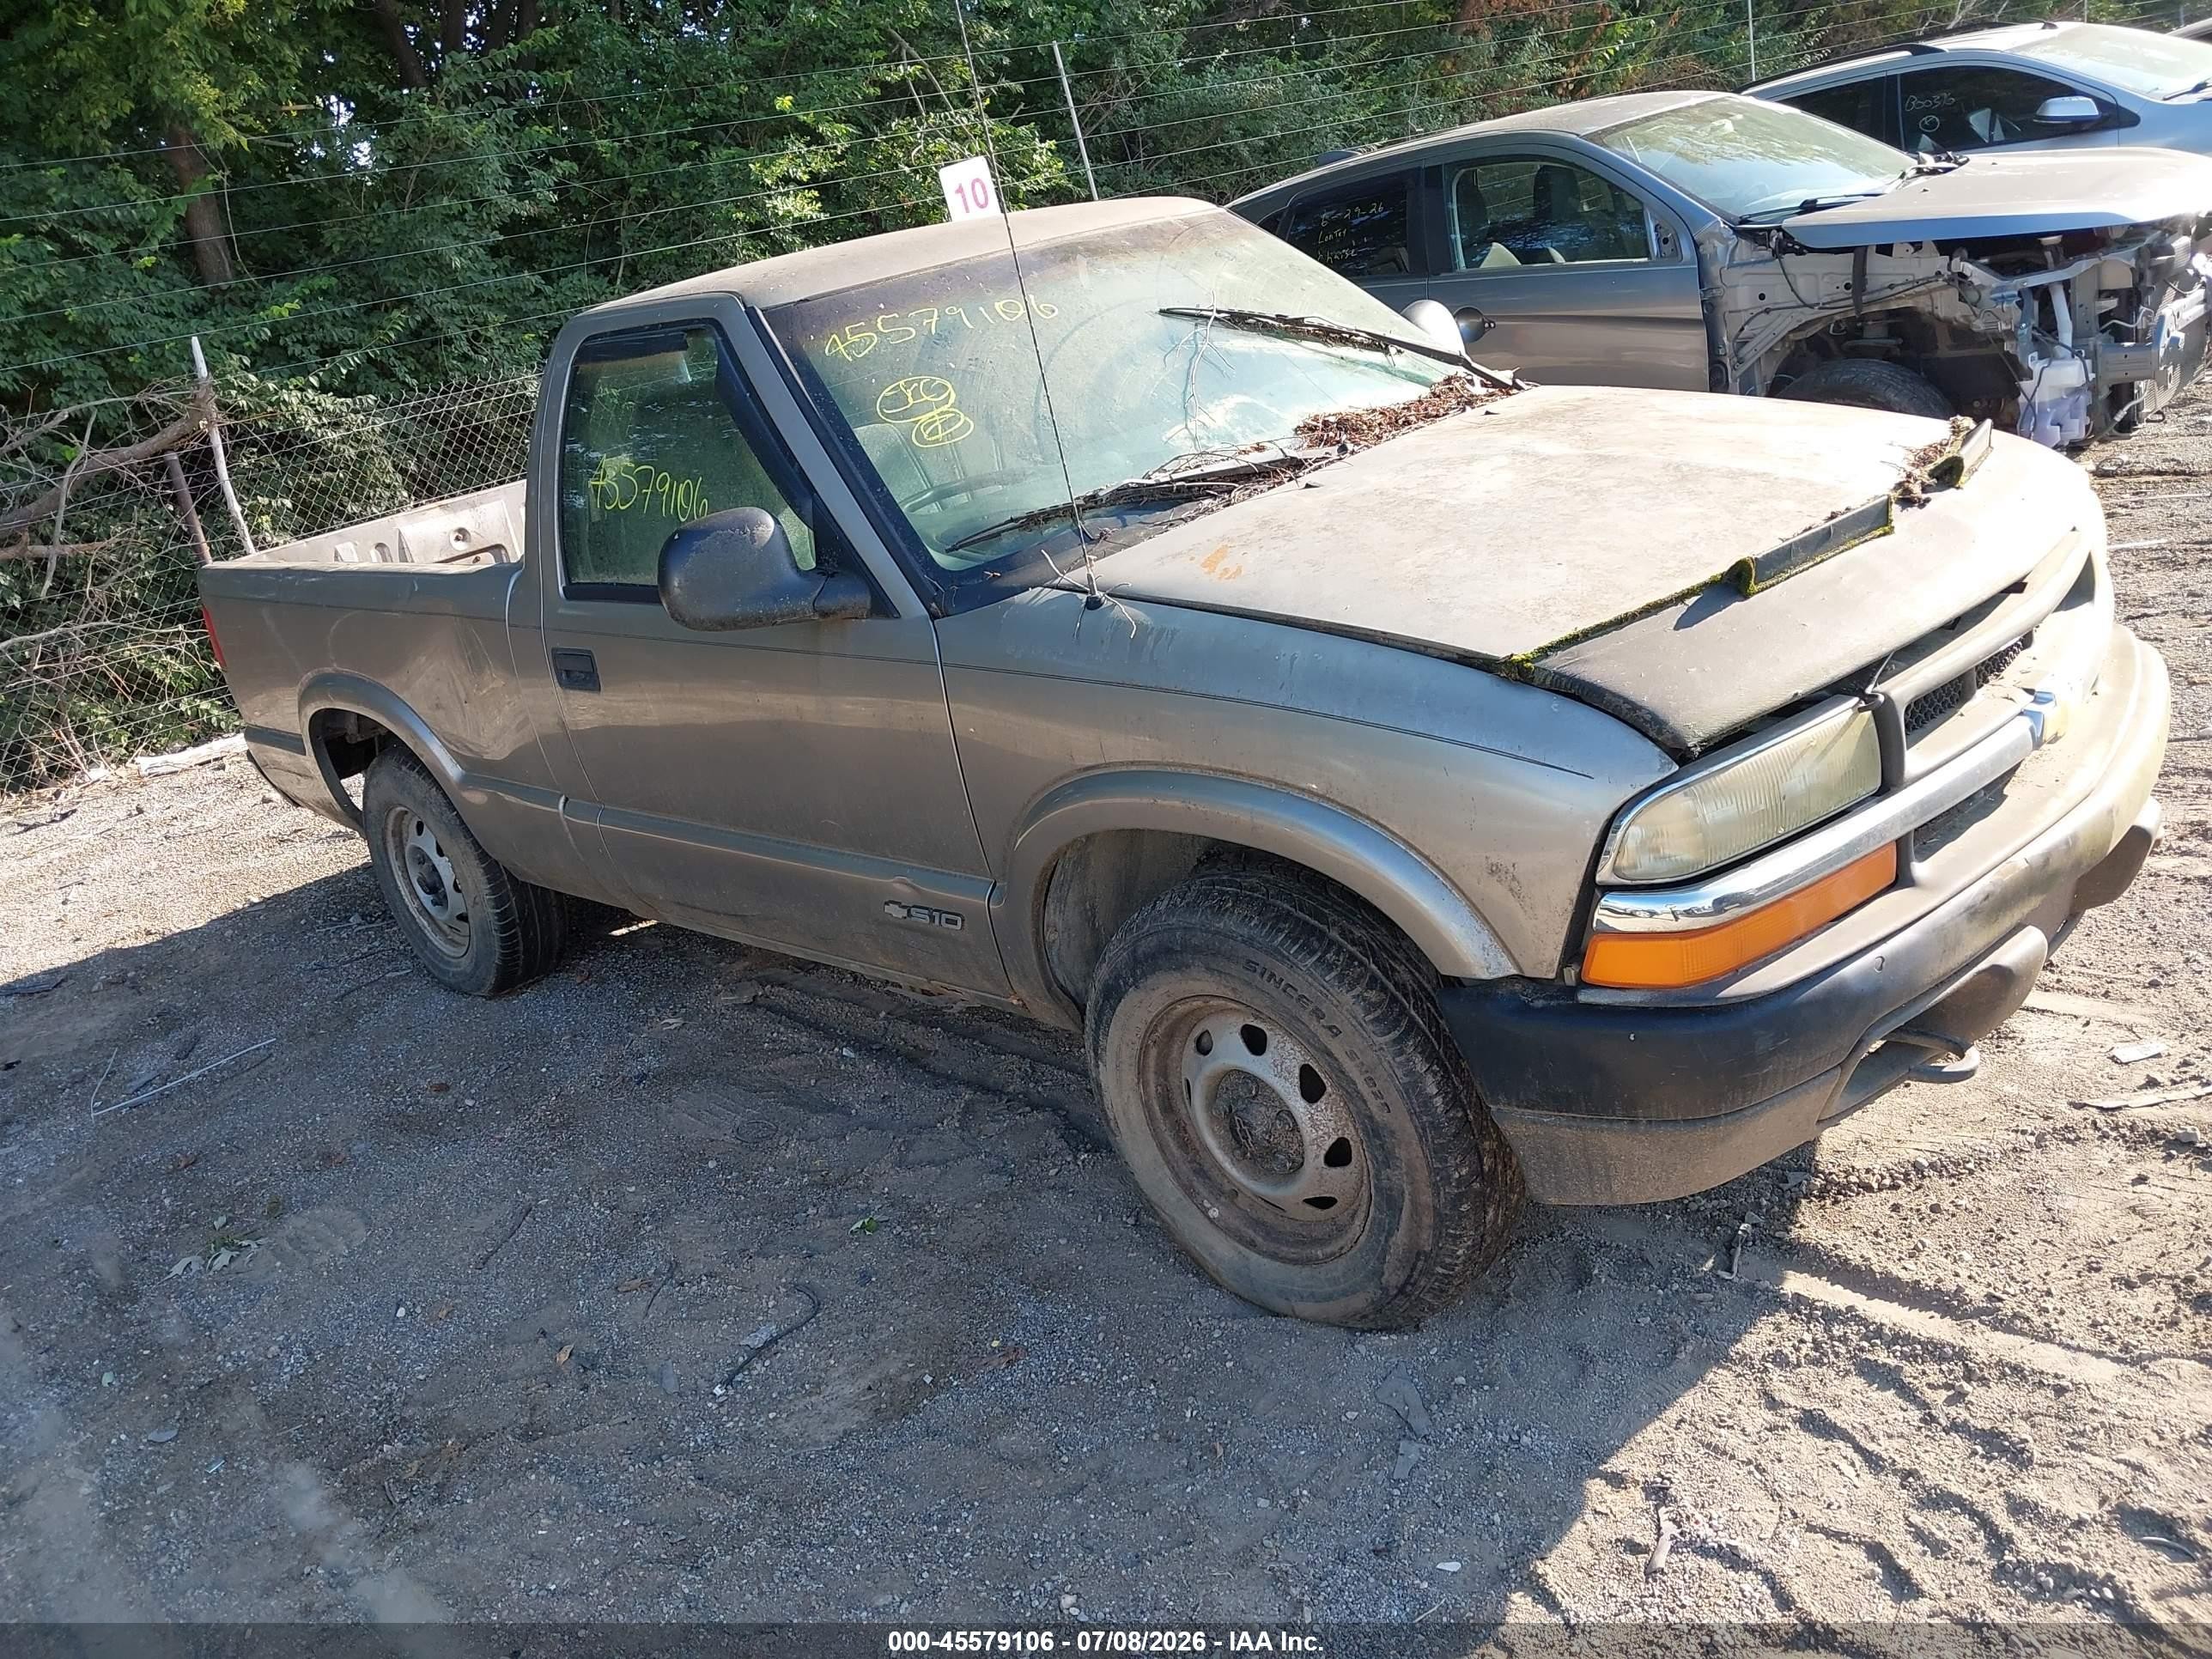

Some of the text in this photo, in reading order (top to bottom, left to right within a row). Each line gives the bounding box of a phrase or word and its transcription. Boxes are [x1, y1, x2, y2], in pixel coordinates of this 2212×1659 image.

[954, 177, 989, 214] 10
[824, 294, 1059, 362] 45579106
[909, 906, 963, 931] S10
[1242, 958, 1343, 1039] SINCERA
